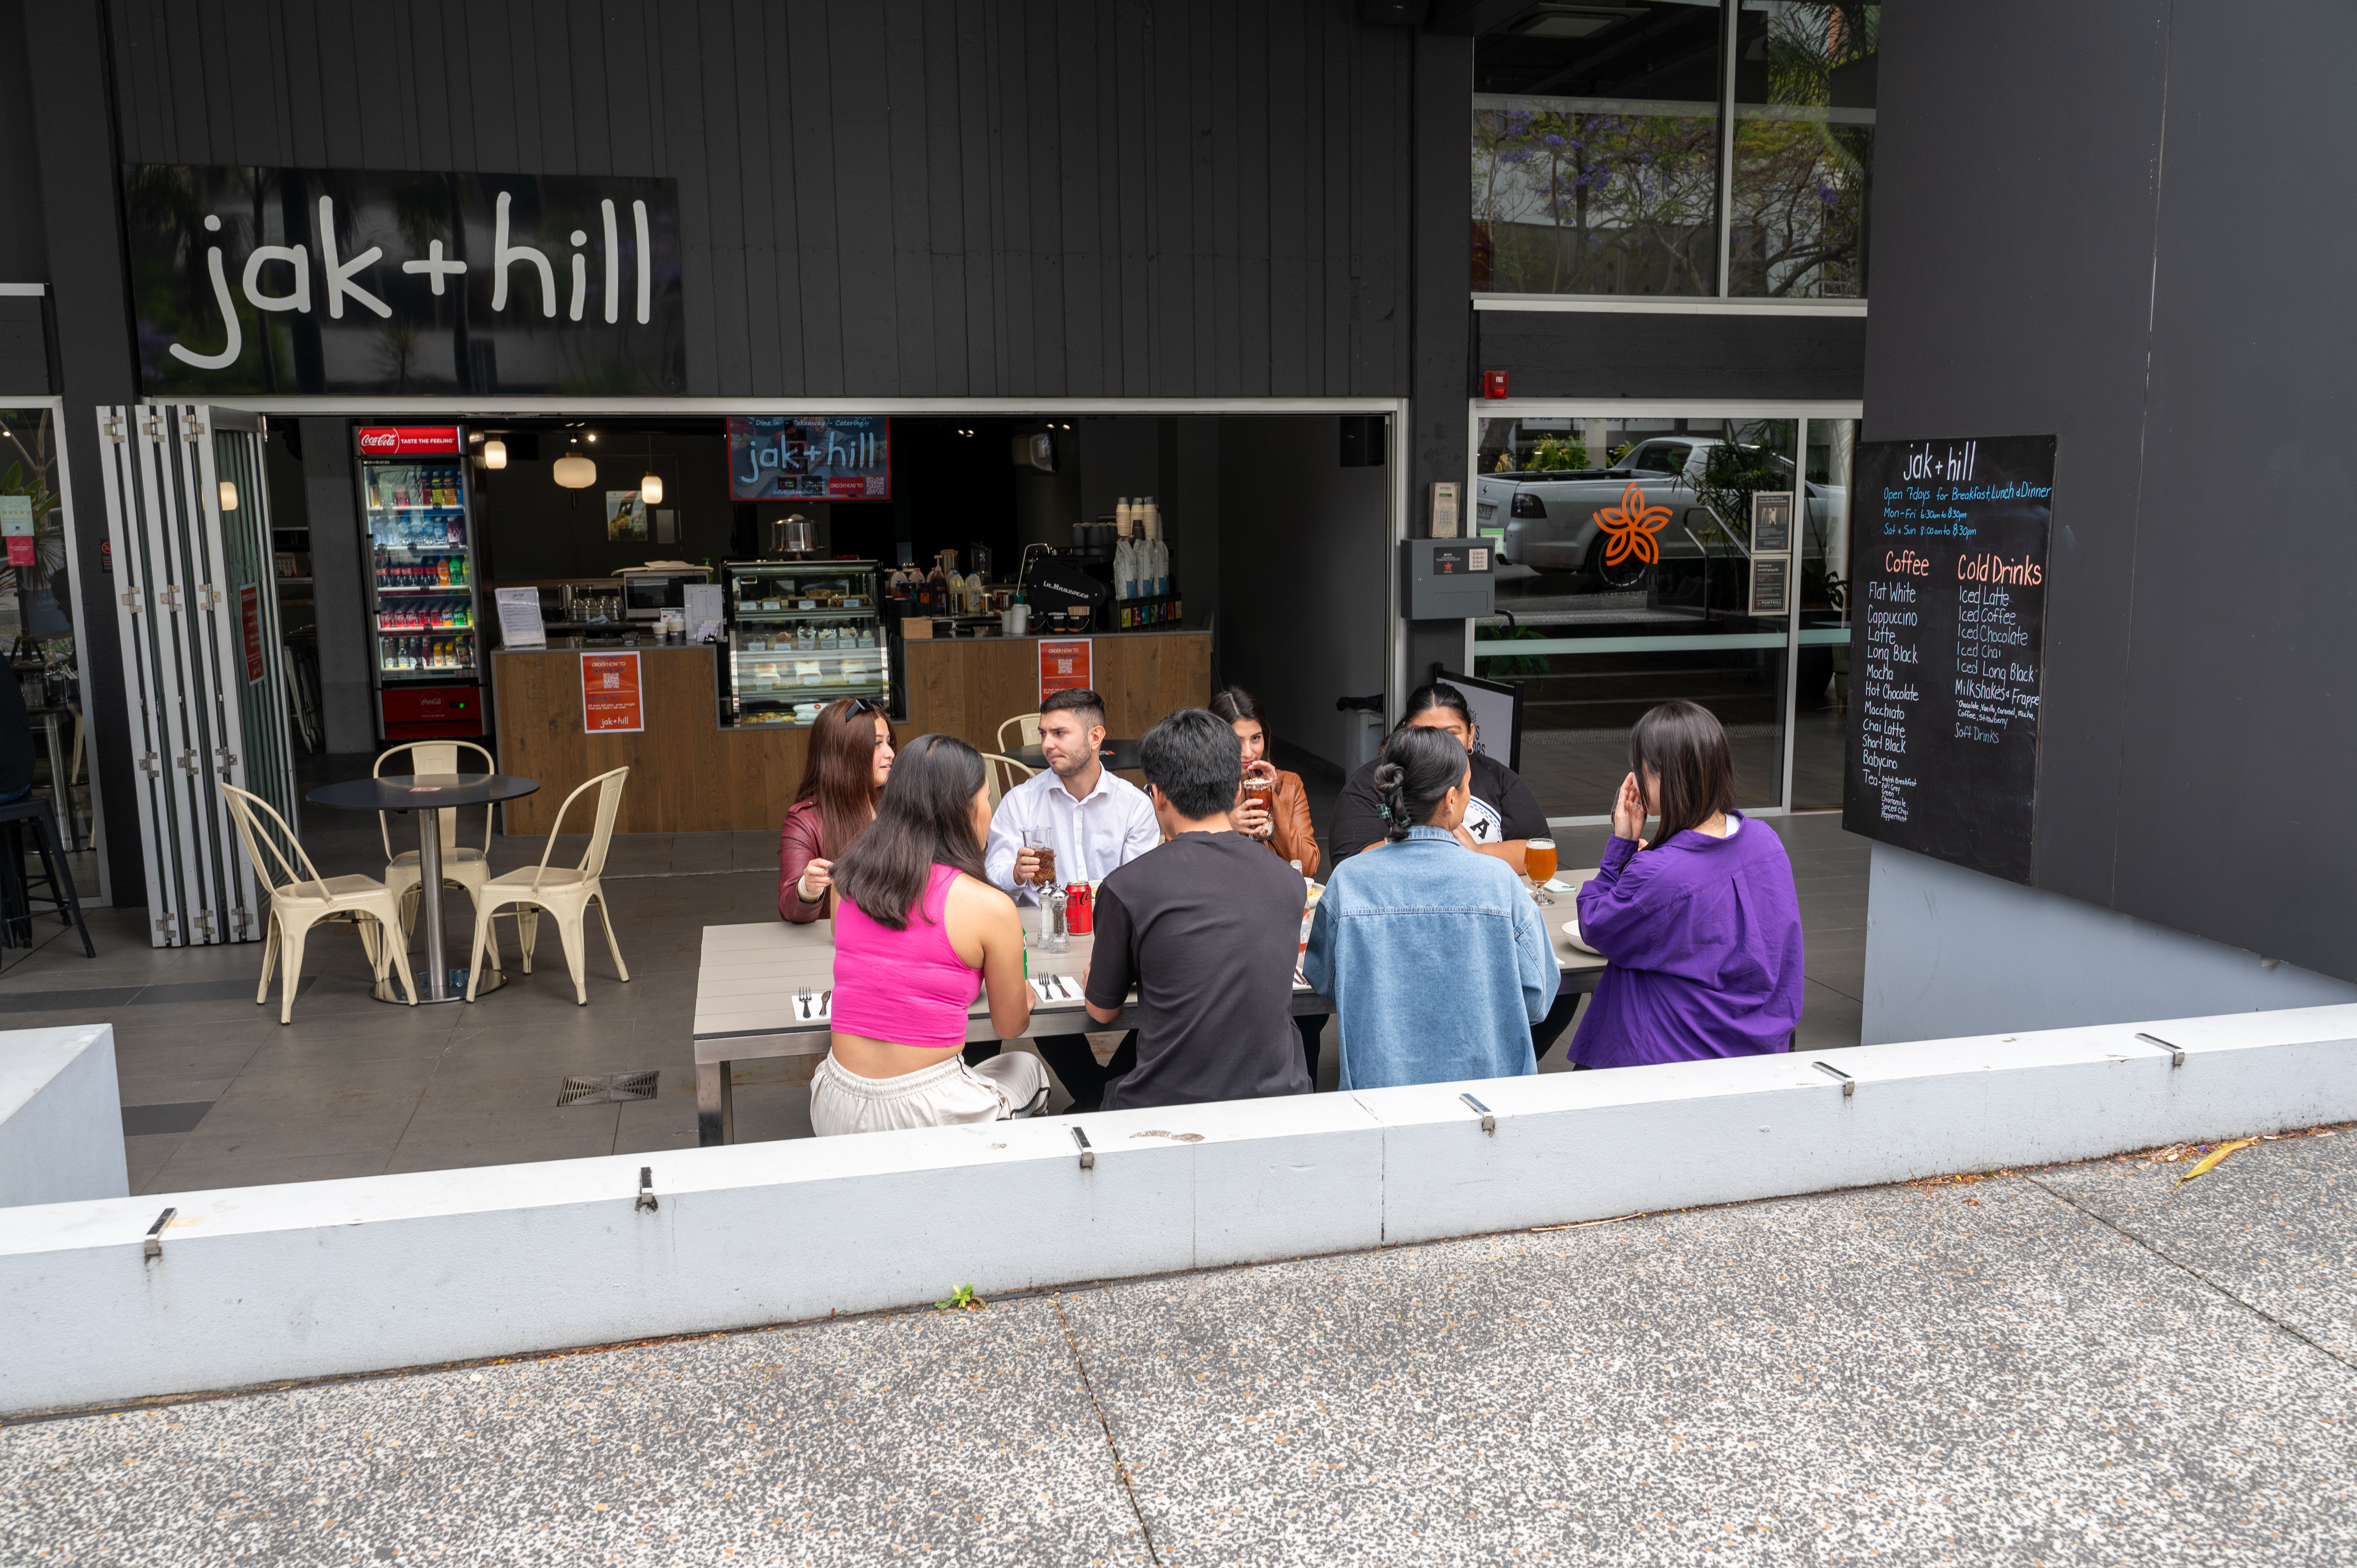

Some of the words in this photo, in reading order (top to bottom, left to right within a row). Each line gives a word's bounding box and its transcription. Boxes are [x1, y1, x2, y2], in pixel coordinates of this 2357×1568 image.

[169, 195, 393, 370] jak
[403, 239, 466, 295] +
[491, 191, 650, 324] hill
[792, 419, 825, 427] Takeaway
[835, 419, 863, 427] Catering
[361, 434, 397, 447] Coca-Cola
[739, 434, 799, 483] jak
[804, 445, 821, 461] +
[828, 431, 874, 468] hill
[1903, 443, 1933, 481] jak
[1935, 461, 1943, 475] +
[1947, 441, 1976, 482] hill
[1884, 487, 1903, 506] Open
[1936, 486, 1948, 501] for
[2021, 481, 2051, 498] Dinner
[1941, 510, 1947, 518] to
[1883, 523, 1896, 535] Sat
[1903, 526, 1916, 535] Sun
[1921, 526, 1942, 535] 8:00am
[1943, 524, 1951, 536] to
[1885, 549, 1929, 577] Coffee
[1958, 553, 1990, 582] Cold
[1992, 554, 2042, 586] Drinks
[1869, 581, 1887, 600] Flat
[1890, 581, 1916, 604] White
[1959, 584, 1980, 604] Iced
[1984, 586, 2009, 606] Latte
[1868, 604, 1917, 629] Cappuccino
[1959, 605, 1979, 622] Iced
[1981, 607, 2016, 625] Coffee
[1868, 626, 1896, 645] Latte
[1958, 622, 1978, 640] Iced
[1980, 625, 2028, 646] Chocolate
[1867, 645, 1889, 669] Long
[1893, 644, 1918, 664] Black
[1958, 641, 1978, 658] Iced
[1981, 645, 2001, 659] Chai
[1867, 663, 1893, 680] Mocha
[1957, 658, 1978, 675] Iced
[1982, 661, 2006, 686] Long
[2010, 663, 2034, 683] Black
[1866, 681, 1880, 697] Hot
[1883, 683, 1919, 701] Chocolate
[2012, 687, 2040, 709] Frappe
[1865, 700, 1905, 720] Macchiato
[600, 717, 613, 728] jak
[618, 716, 629, 725] hill
[1863, 719, 1881, 732] Chai
[1884, 720, 1906, 738] Latte
[1954, 722, 1972, 738] Soft
[1974, 726, 1999, 743] Drinks
[1862, 735, 1882, 750] Short
[1885, 736, 1906, 754] Black
[1863, 749, 1898, 776] Babycino
[1881, 782, 1890, 791] Earl
[1890, 784, 1900, 794] Grey
[1882, 775, 1895, 784] English
[1895, 777, 1917, 788] Breakfast
[1881, 789, 1894, 798] Green
[1881, 795, 1906, 807] Chamomile
[1881, 802, 1897, 812] Spiced
[1898, 806, 1909, 815] Chai
[1881, 810, 1907, 823] Peppermint
[1469, 818, 1489, 840] A
